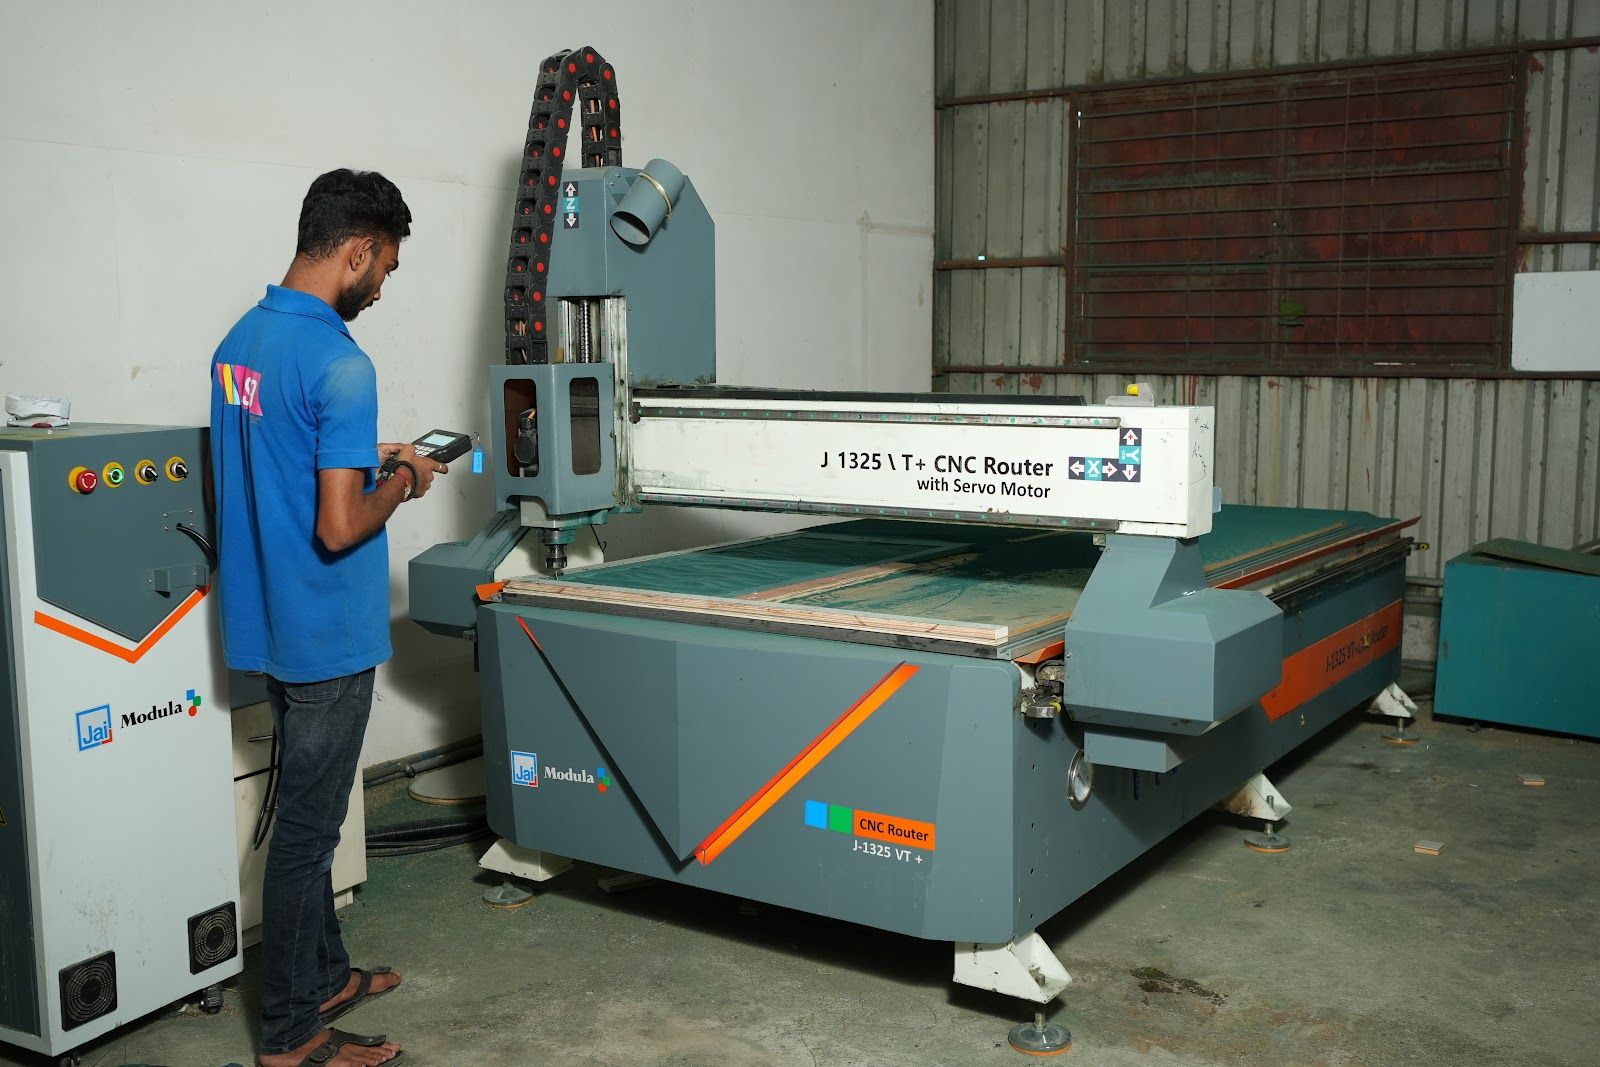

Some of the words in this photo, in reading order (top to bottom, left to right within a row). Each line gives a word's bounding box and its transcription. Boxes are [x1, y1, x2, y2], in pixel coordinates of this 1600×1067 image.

[566, 198, 576, 210] Z
[821, 452, 828, 468] J
[838, 452, 882, 470] 1325
[901, 454, 926, 470] T+
[934, 455, 977, 473] CNC
[984, 456, 1054, 476] Router
[1125, 448, 1140, 463] Y
[1088, 460, 1100, 474] X
[917, 478, 949, 492] with
[953, 478, 996, 494] Servo
[1001, 482, 1051, 498] Motor
[82, 720, 108, 744] Jai
[120, 701, 182, 728] Modula
[516, 766, 534, 781] Jai
[544, 766, 594, 784] Modula
[860, 818, 884, 833] CNC
[888, 824, 928, 842] Router
[852, 840, 891, 858] J-1325
